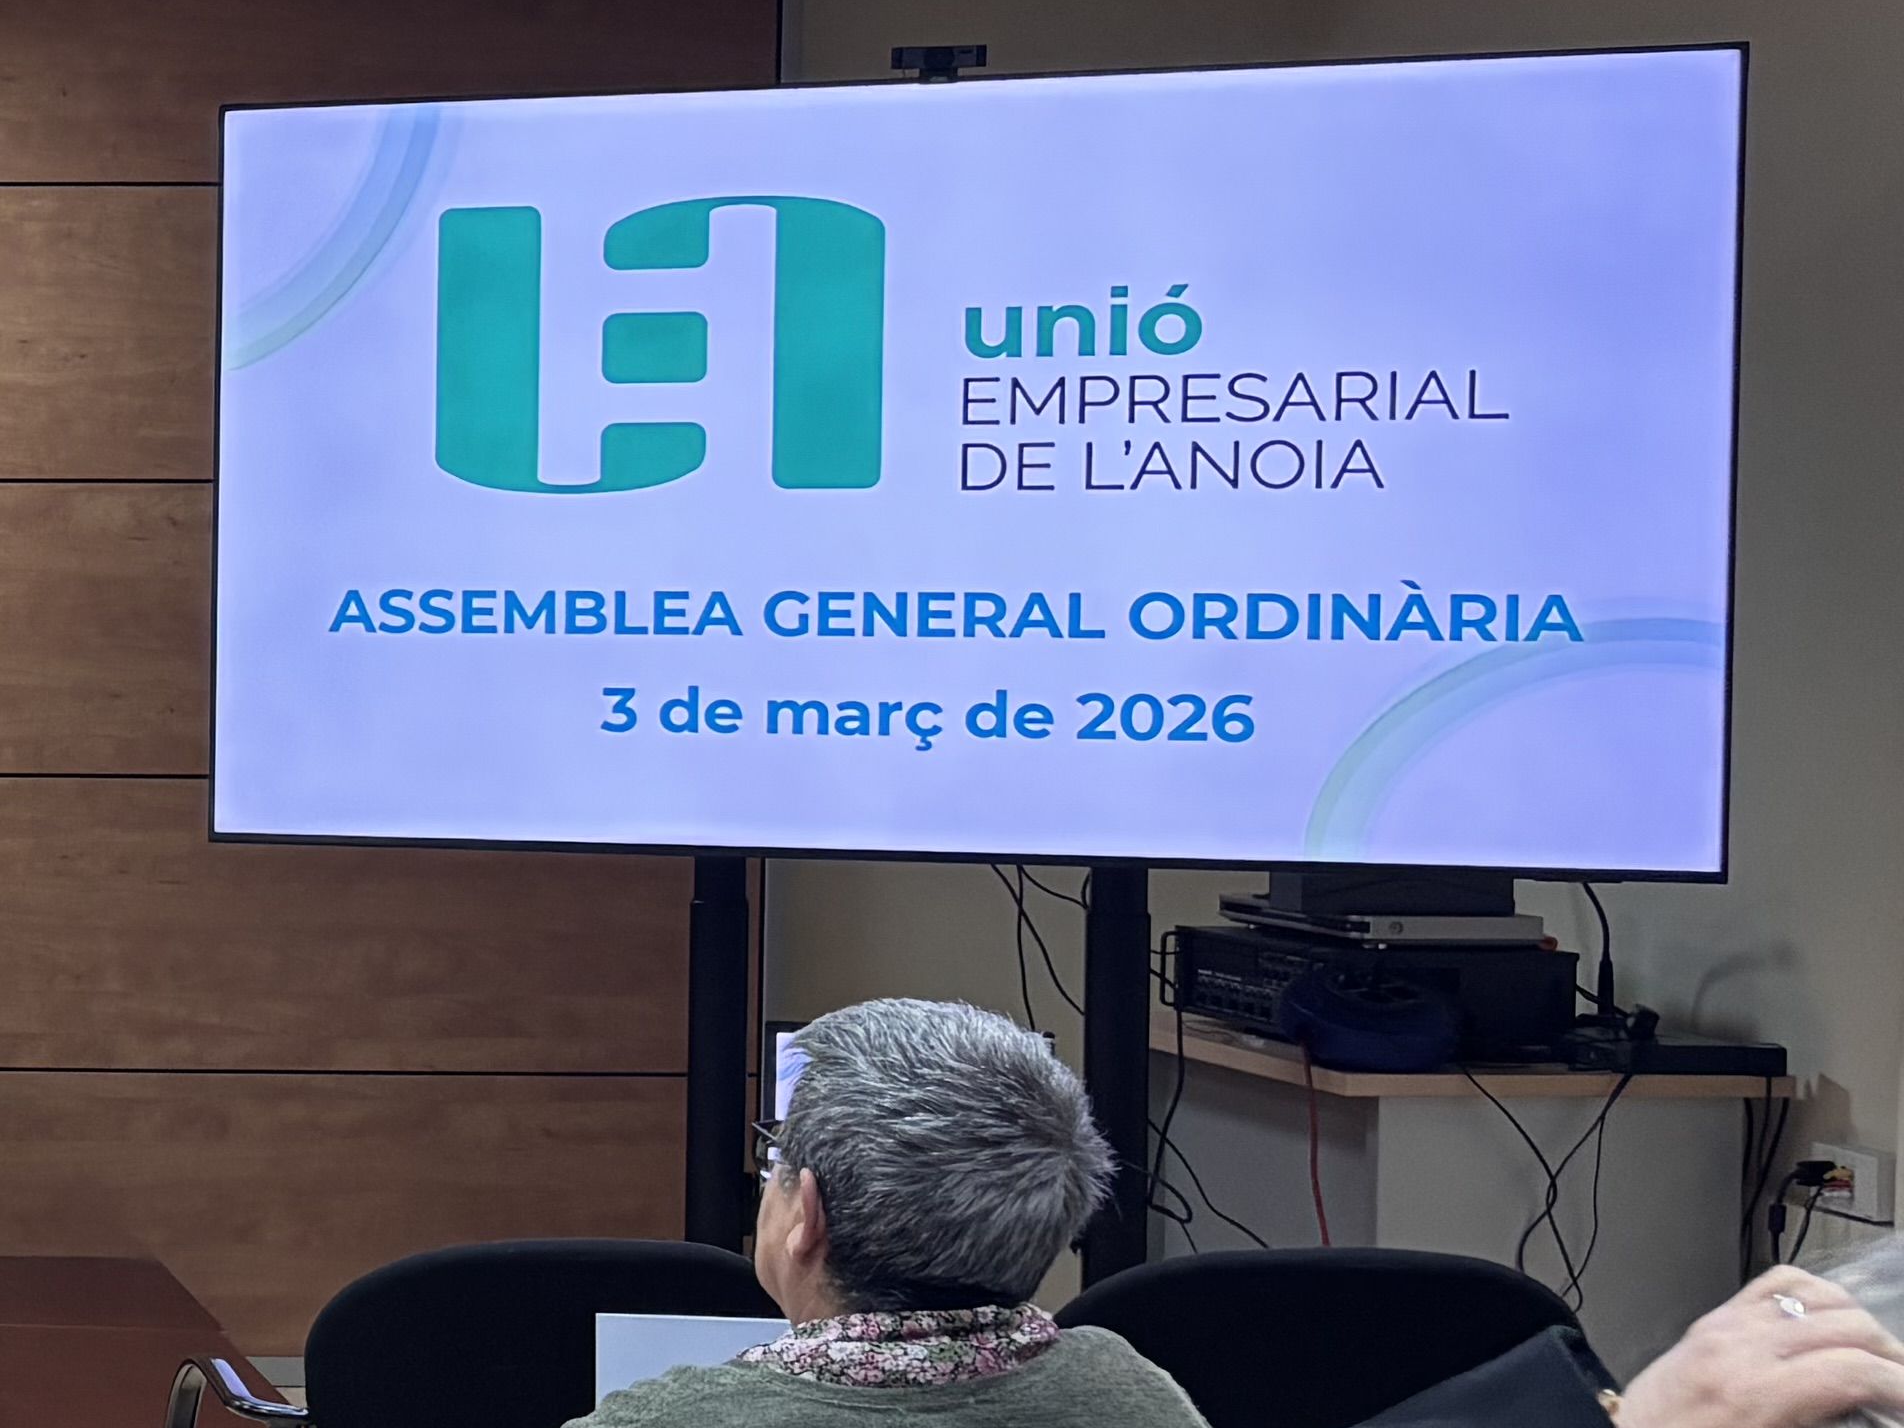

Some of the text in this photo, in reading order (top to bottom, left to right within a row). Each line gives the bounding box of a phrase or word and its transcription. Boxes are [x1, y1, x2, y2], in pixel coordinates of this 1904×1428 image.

[964, 283, 1203, 359] unió
[962, 369, 1510, 426] EMPRESARIAL
[961, 441, 1056, 491] DE
[328, 579, 1586, 643] ASSEMBLEA GENERAL ORDINÀRIA
[600, 685, 1255, 752] 3 de març de 2026
